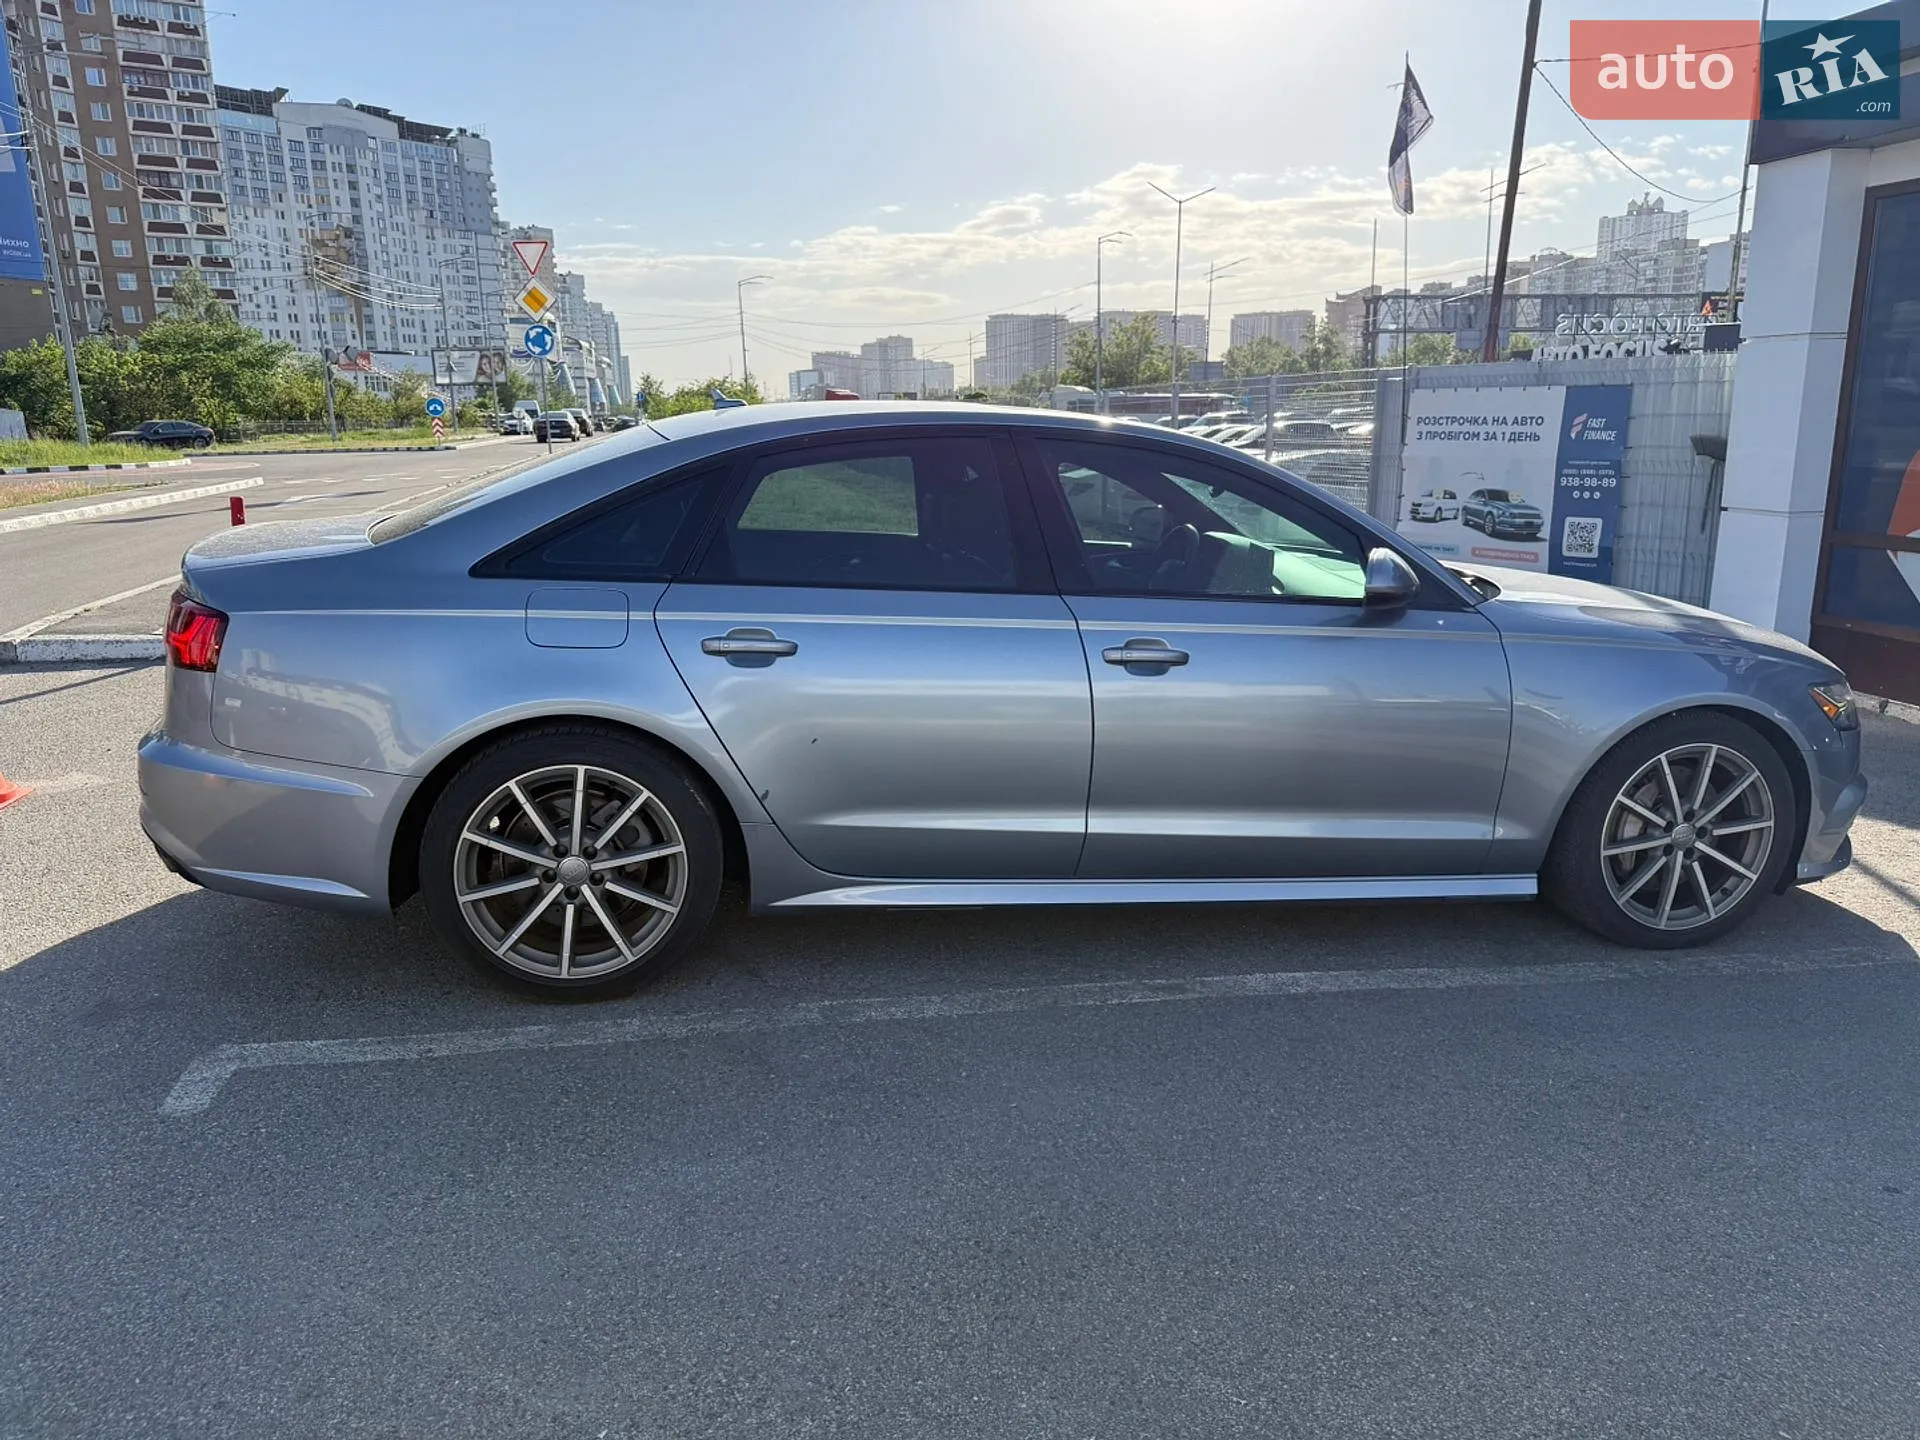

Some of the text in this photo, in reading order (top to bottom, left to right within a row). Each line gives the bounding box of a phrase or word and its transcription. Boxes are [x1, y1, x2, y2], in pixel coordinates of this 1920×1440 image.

[1416, 416, 1545, 427] РОЗСТРОЧКА НА АВТО
[1586, 418, 1607, 428] FAST
[1425, 431, 1480, 441] ПРОБІГОМ
[1483, 431, 1498, 442] ЗА
[1501, 432, 1506, 441] 1
[1507, 432, 1541, 443] ДЕНЬ
[1583, 430, 1617, 441] FINANCE
[1560, 477, 1617, 488] 938-98-89
